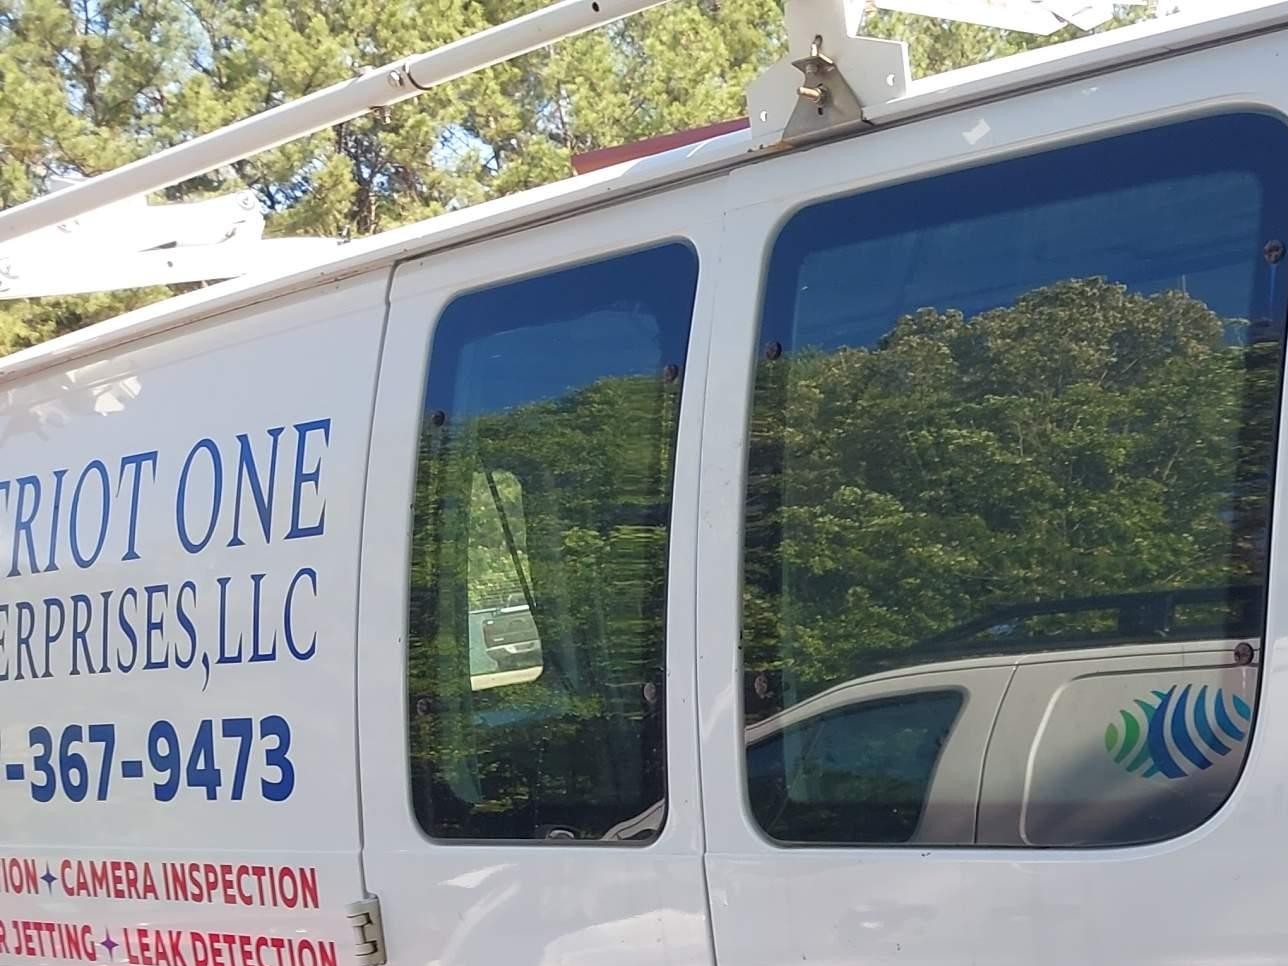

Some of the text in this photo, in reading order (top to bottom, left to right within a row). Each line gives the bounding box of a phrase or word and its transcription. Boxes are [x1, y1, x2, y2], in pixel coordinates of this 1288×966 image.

[176, 417, 332, 554] ONE
[60, 858, 158, 900] CAMERA
[161, 862, 320, 909] INSPECTION
[12, 919, 97, 962] JETTING
